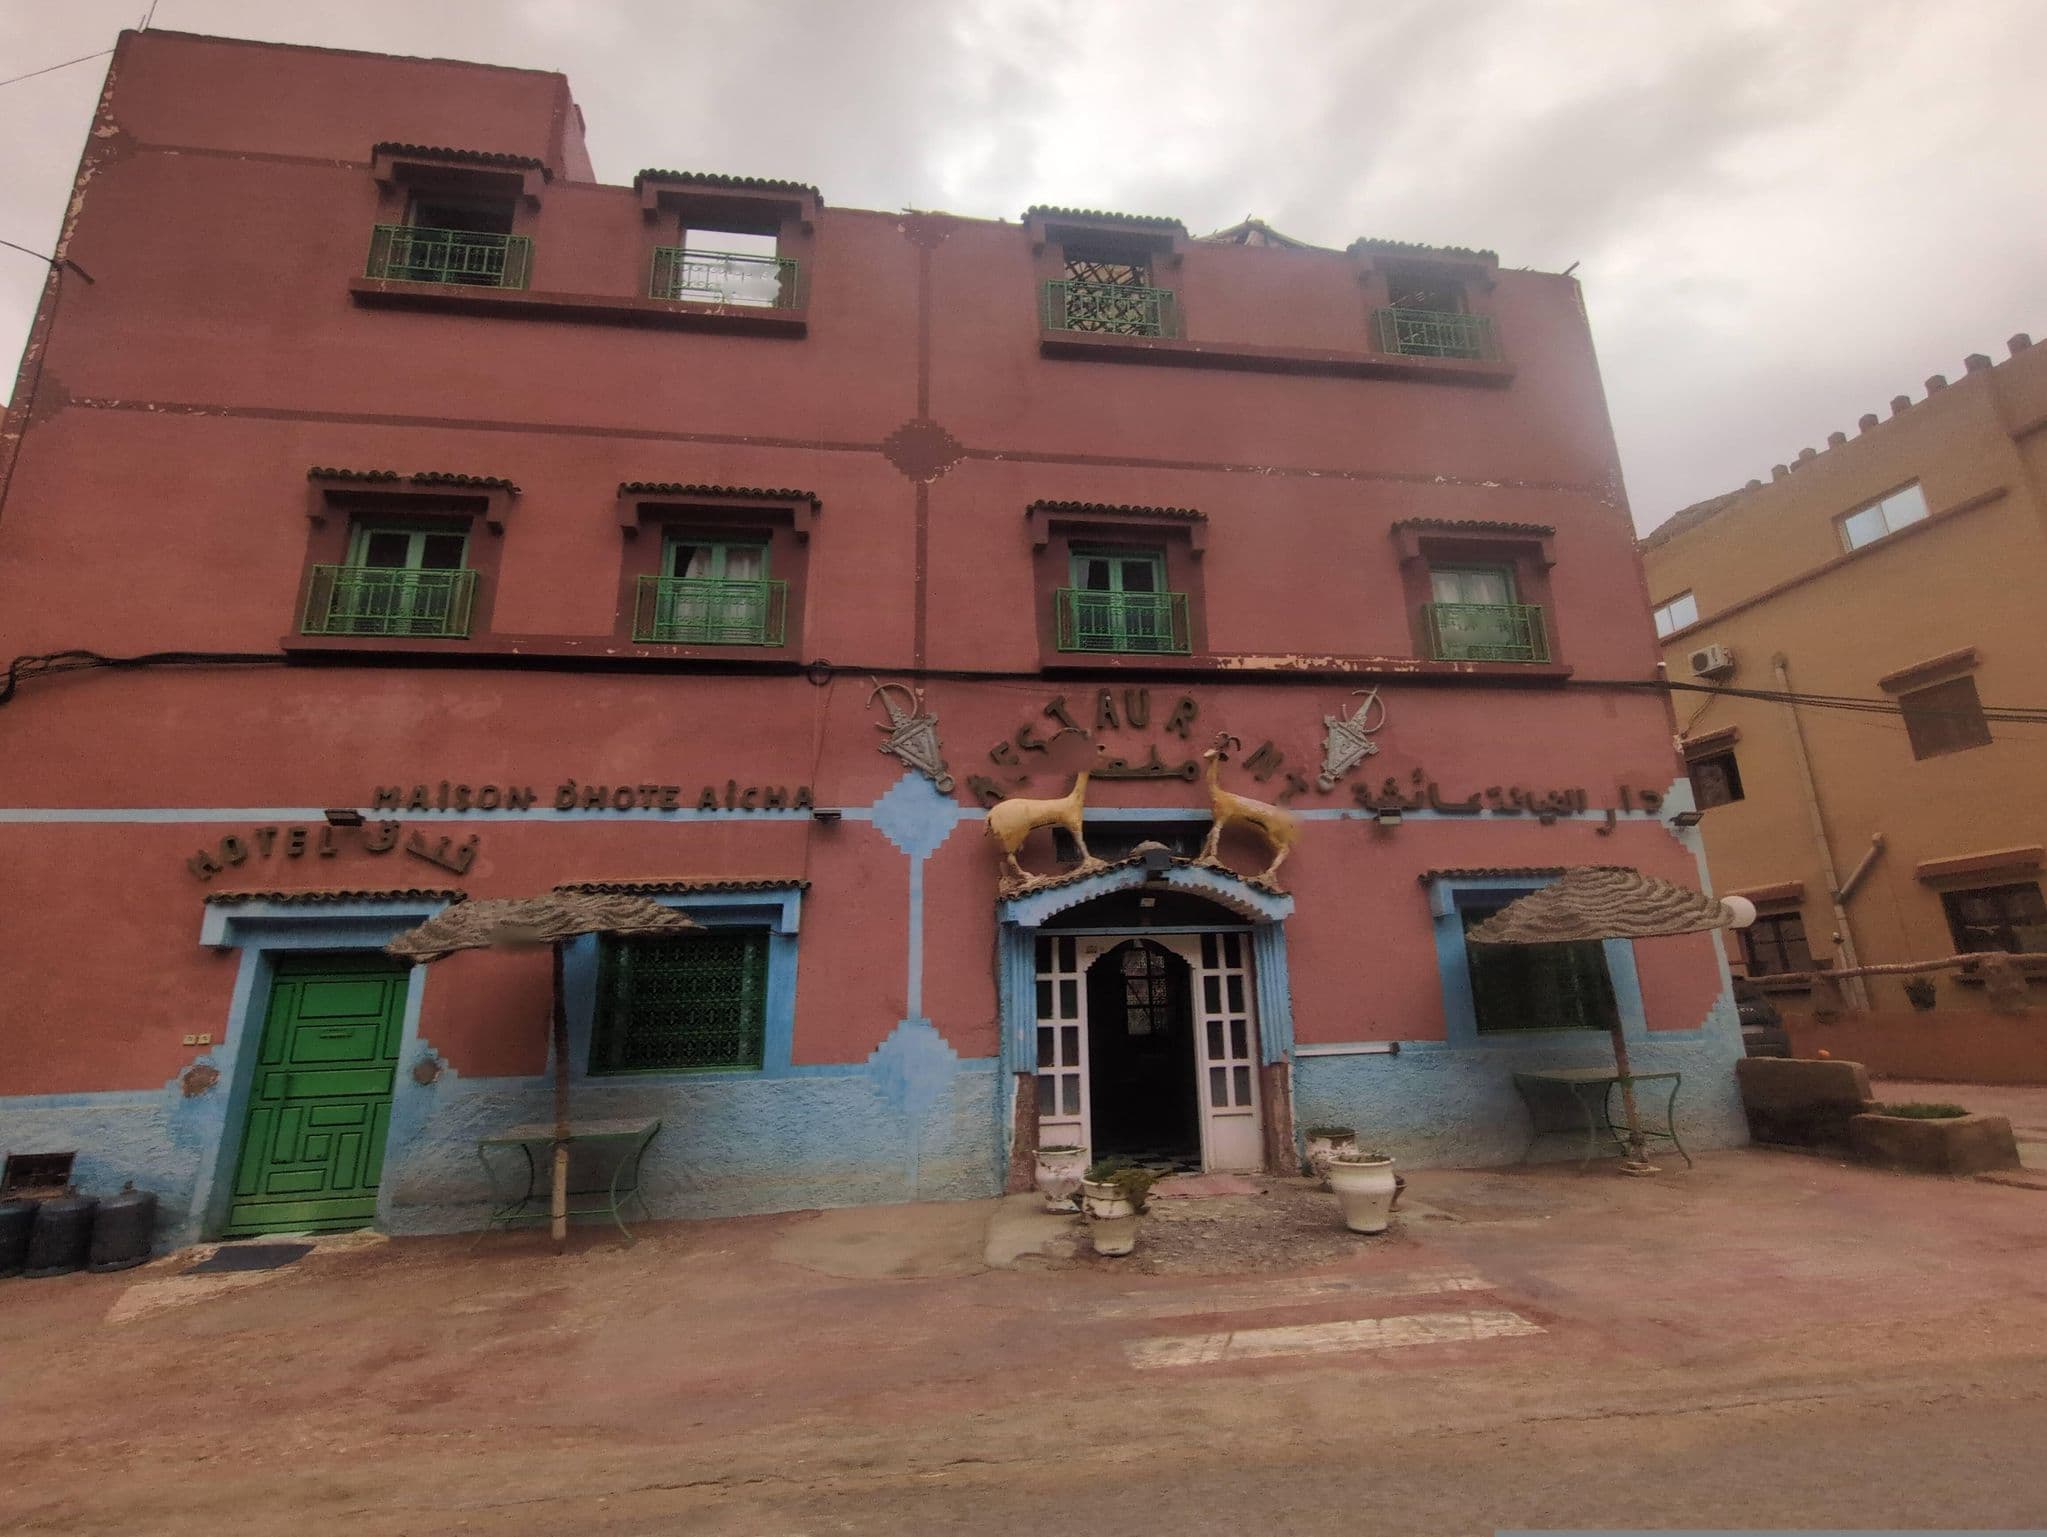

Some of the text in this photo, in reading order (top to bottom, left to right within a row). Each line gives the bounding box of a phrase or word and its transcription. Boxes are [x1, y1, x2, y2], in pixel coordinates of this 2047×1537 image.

[967, 686, 1310, 808] RESTAURNT
[1596, 784, 1664, 837] دار
[186, 825, 338, 881] HOTEL
